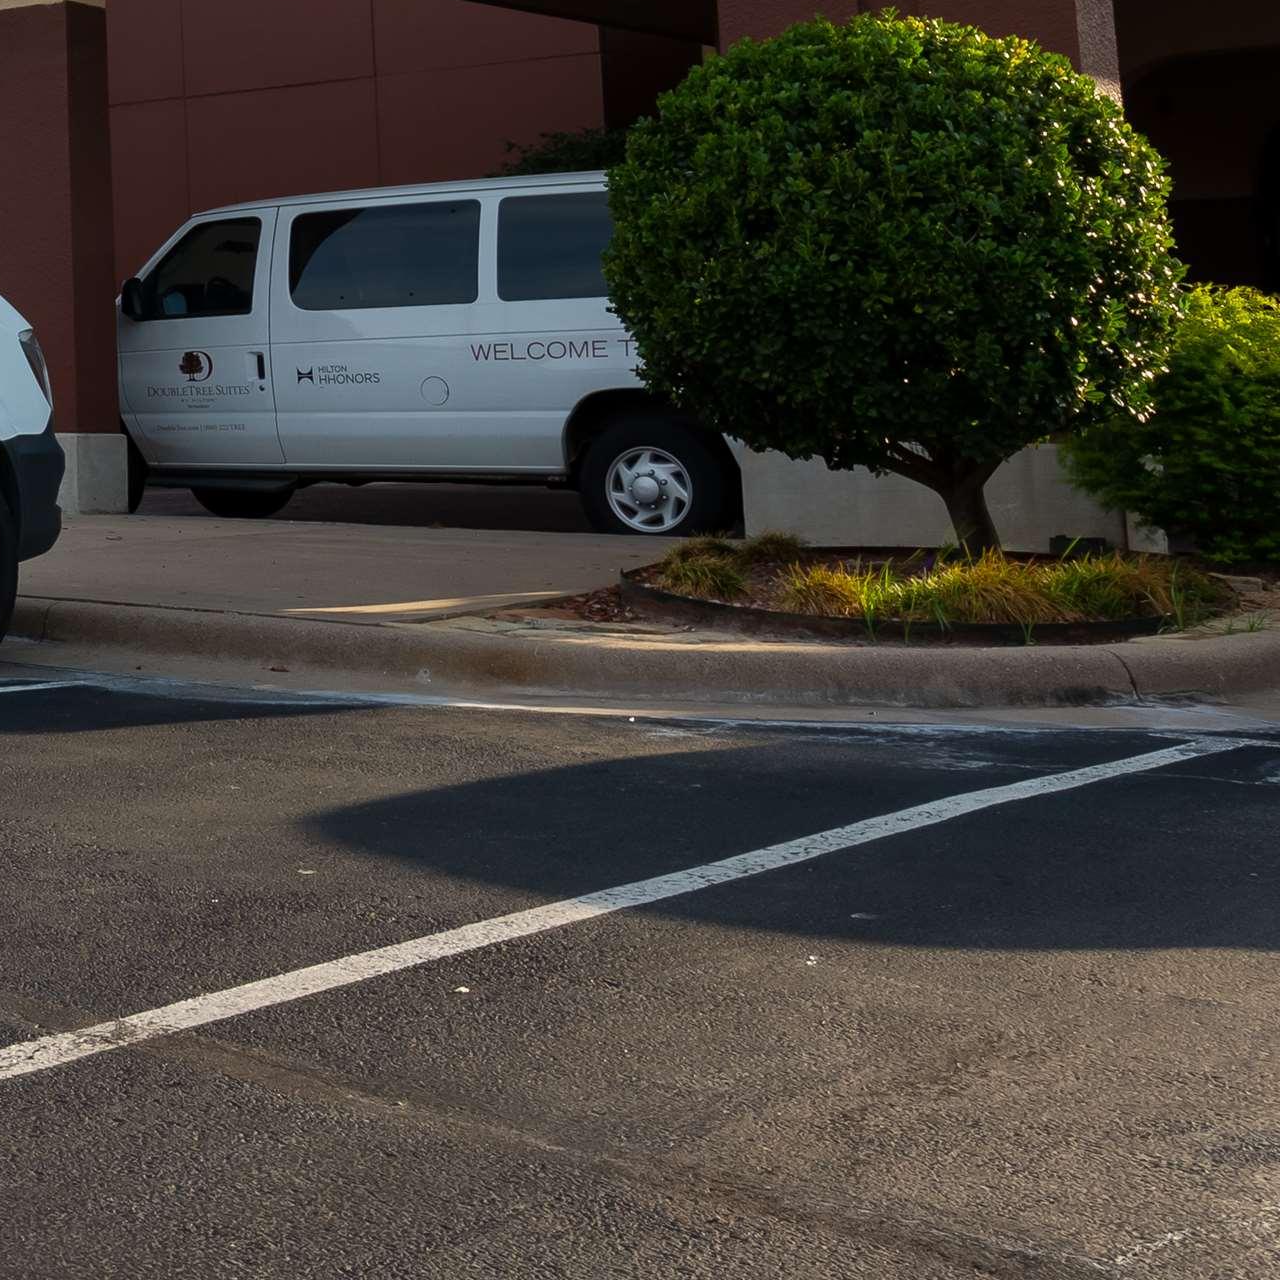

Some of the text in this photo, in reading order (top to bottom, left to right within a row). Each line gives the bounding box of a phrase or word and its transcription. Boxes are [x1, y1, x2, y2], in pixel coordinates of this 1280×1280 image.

[470, 339, 638, 361] WELCOME T
[318, 365, 347, 374] HILTON
[319, 372, 381, 385] HHONORS
